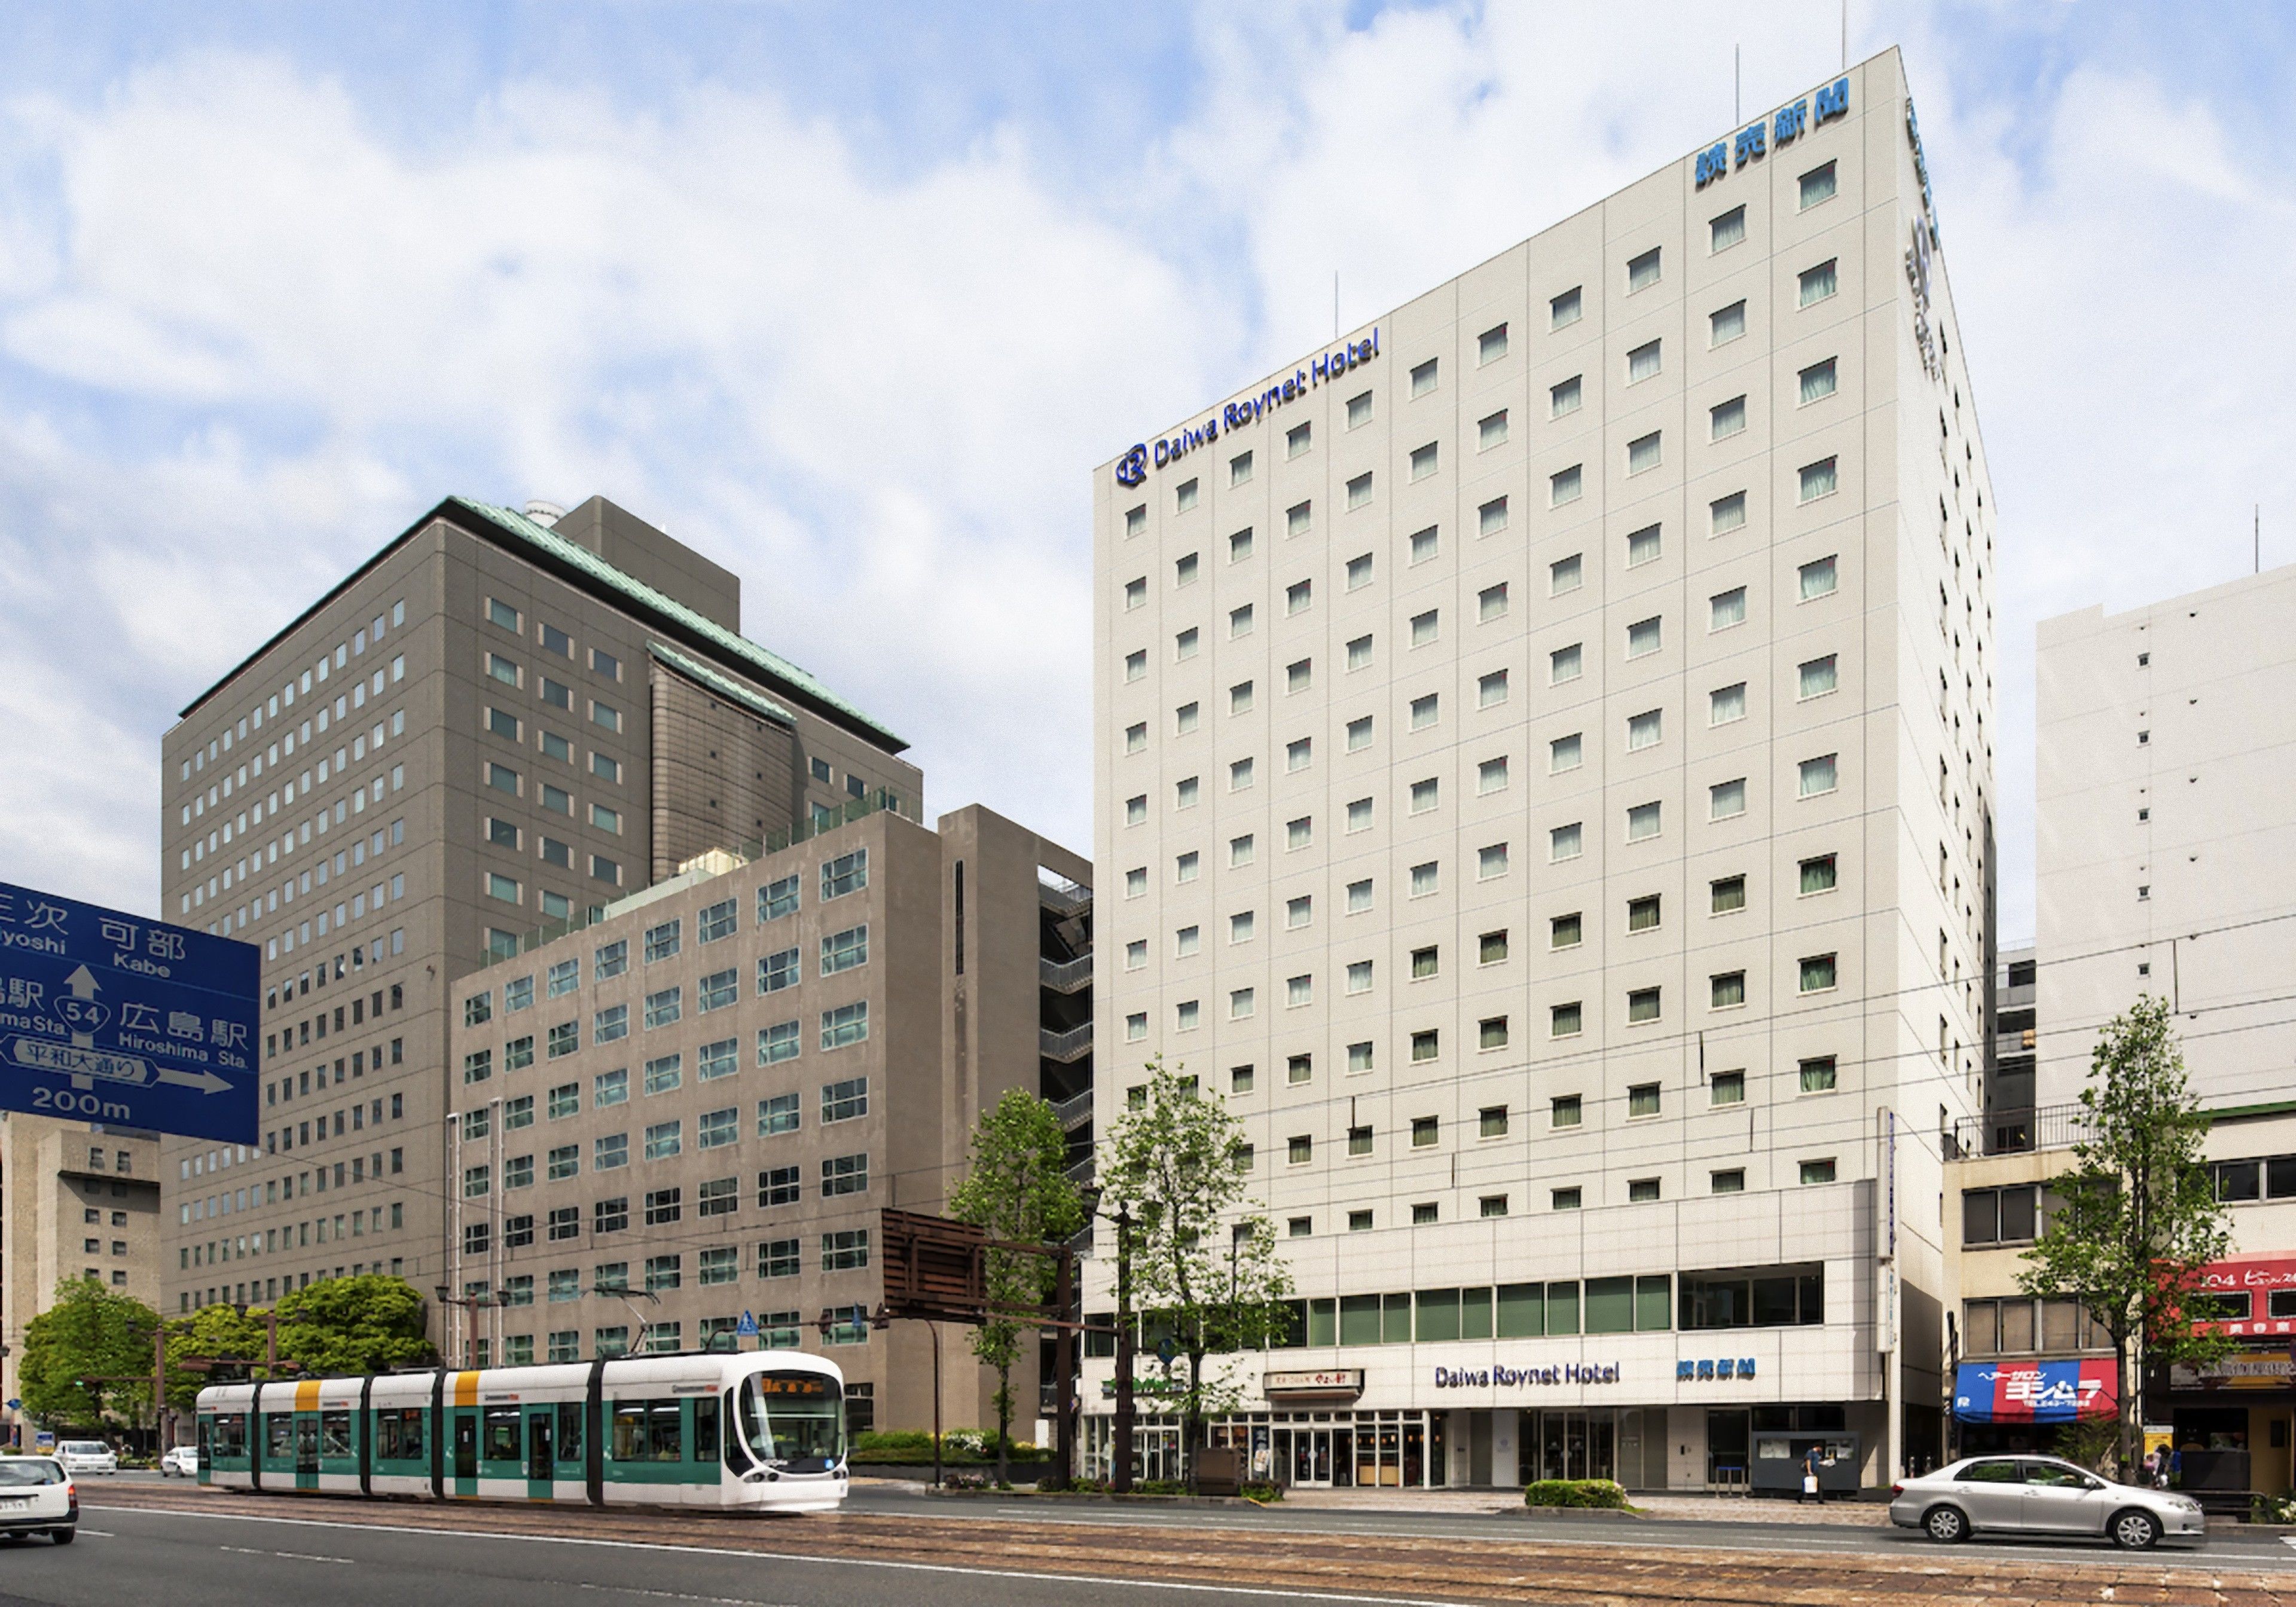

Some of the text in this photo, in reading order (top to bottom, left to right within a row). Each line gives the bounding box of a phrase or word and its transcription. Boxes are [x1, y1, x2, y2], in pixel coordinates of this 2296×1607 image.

[1155, 327, 1379, 466] Daiwa Roynet Hotel
[0, 928, 66, 955] yoshi
[98, 917, 186, 961] 可部
[114, 952, 171, 978] Kabe
[0, 977, 45, 1012] 駅
[66, 1002, 99, 1025] 54
[120, 1003, 249, 1051] 広島駅
[27, 1043, 135, 1077] 平和大通り
[120, 1032, 248, 1069] Hiroshima Sta.
[33, 1086, 130, 1120] 200m
[1436, 1361, 1619, 1391] Daiwa Roynet Hotel
